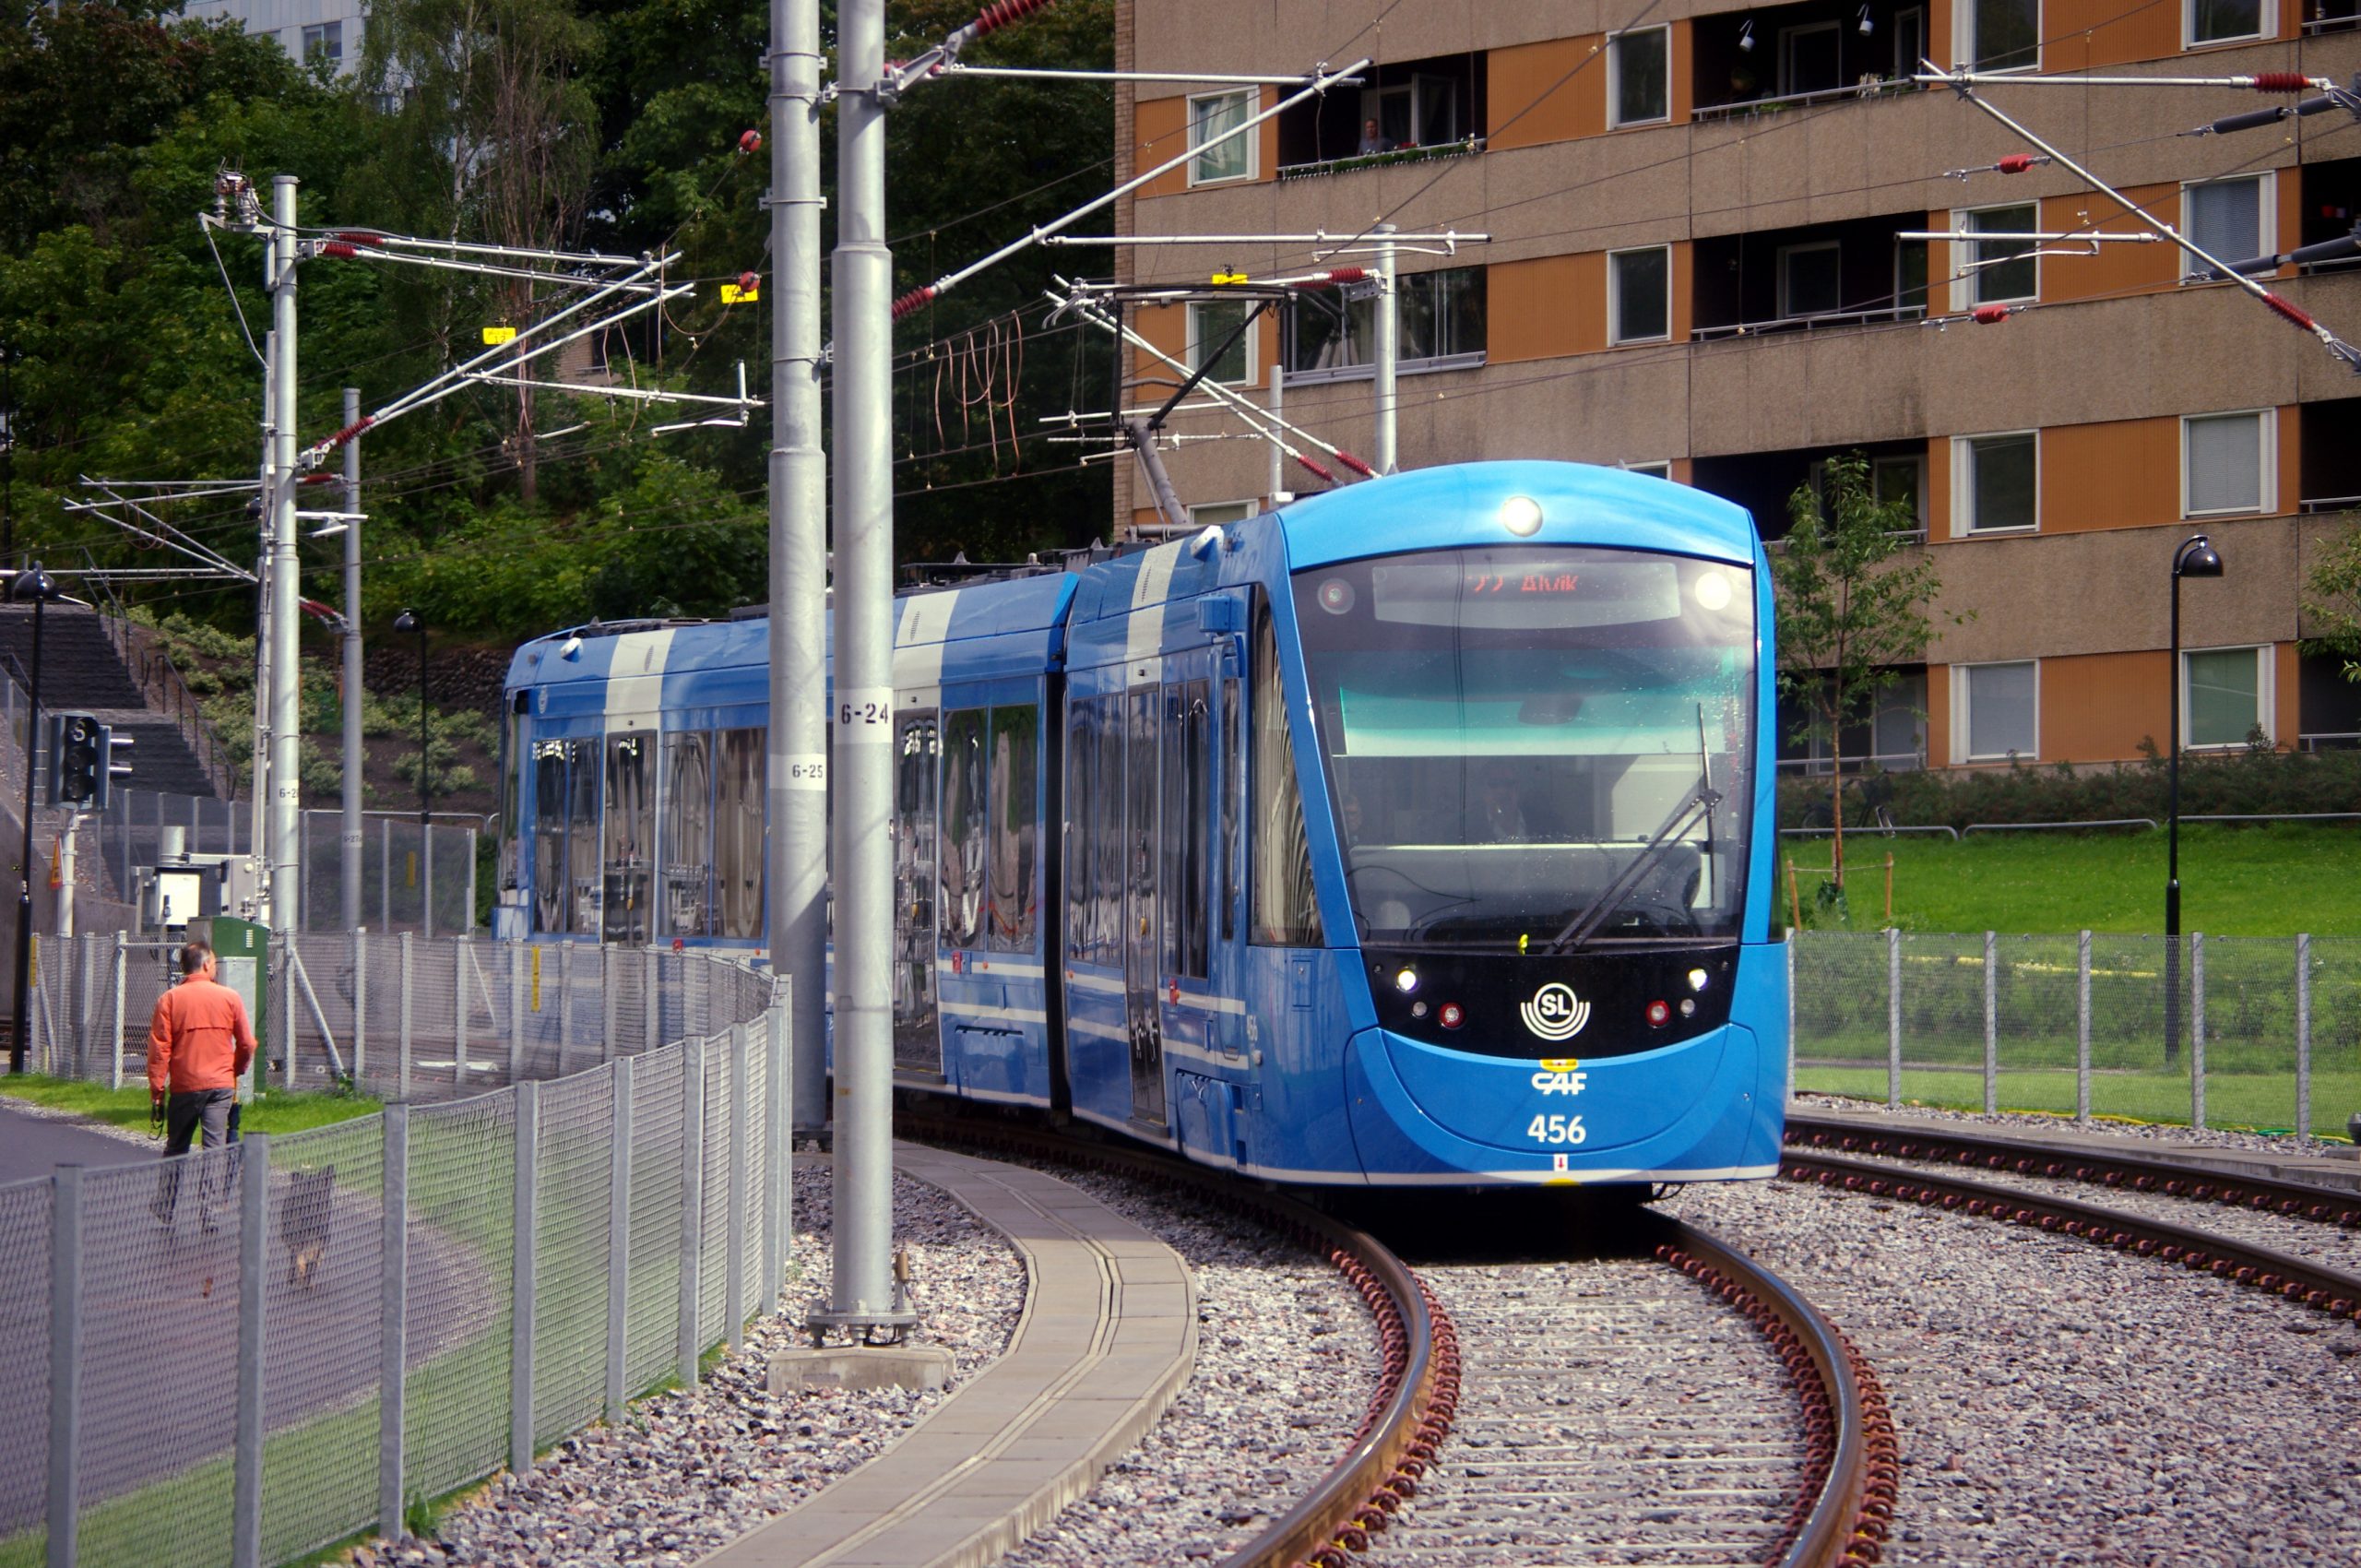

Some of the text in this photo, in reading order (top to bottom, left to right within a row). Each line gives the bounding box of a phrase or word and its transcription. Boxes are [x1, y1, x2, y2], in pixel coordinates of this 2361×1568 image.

[841, 703, 889, 725] 6-24
[792, 764, 824, 778] 6-25
[1541, 993, 1571, 1016] SL
[1531, 1073, 1587, 1095] CAF
[1527, 1114, 1586, 1144] 456
